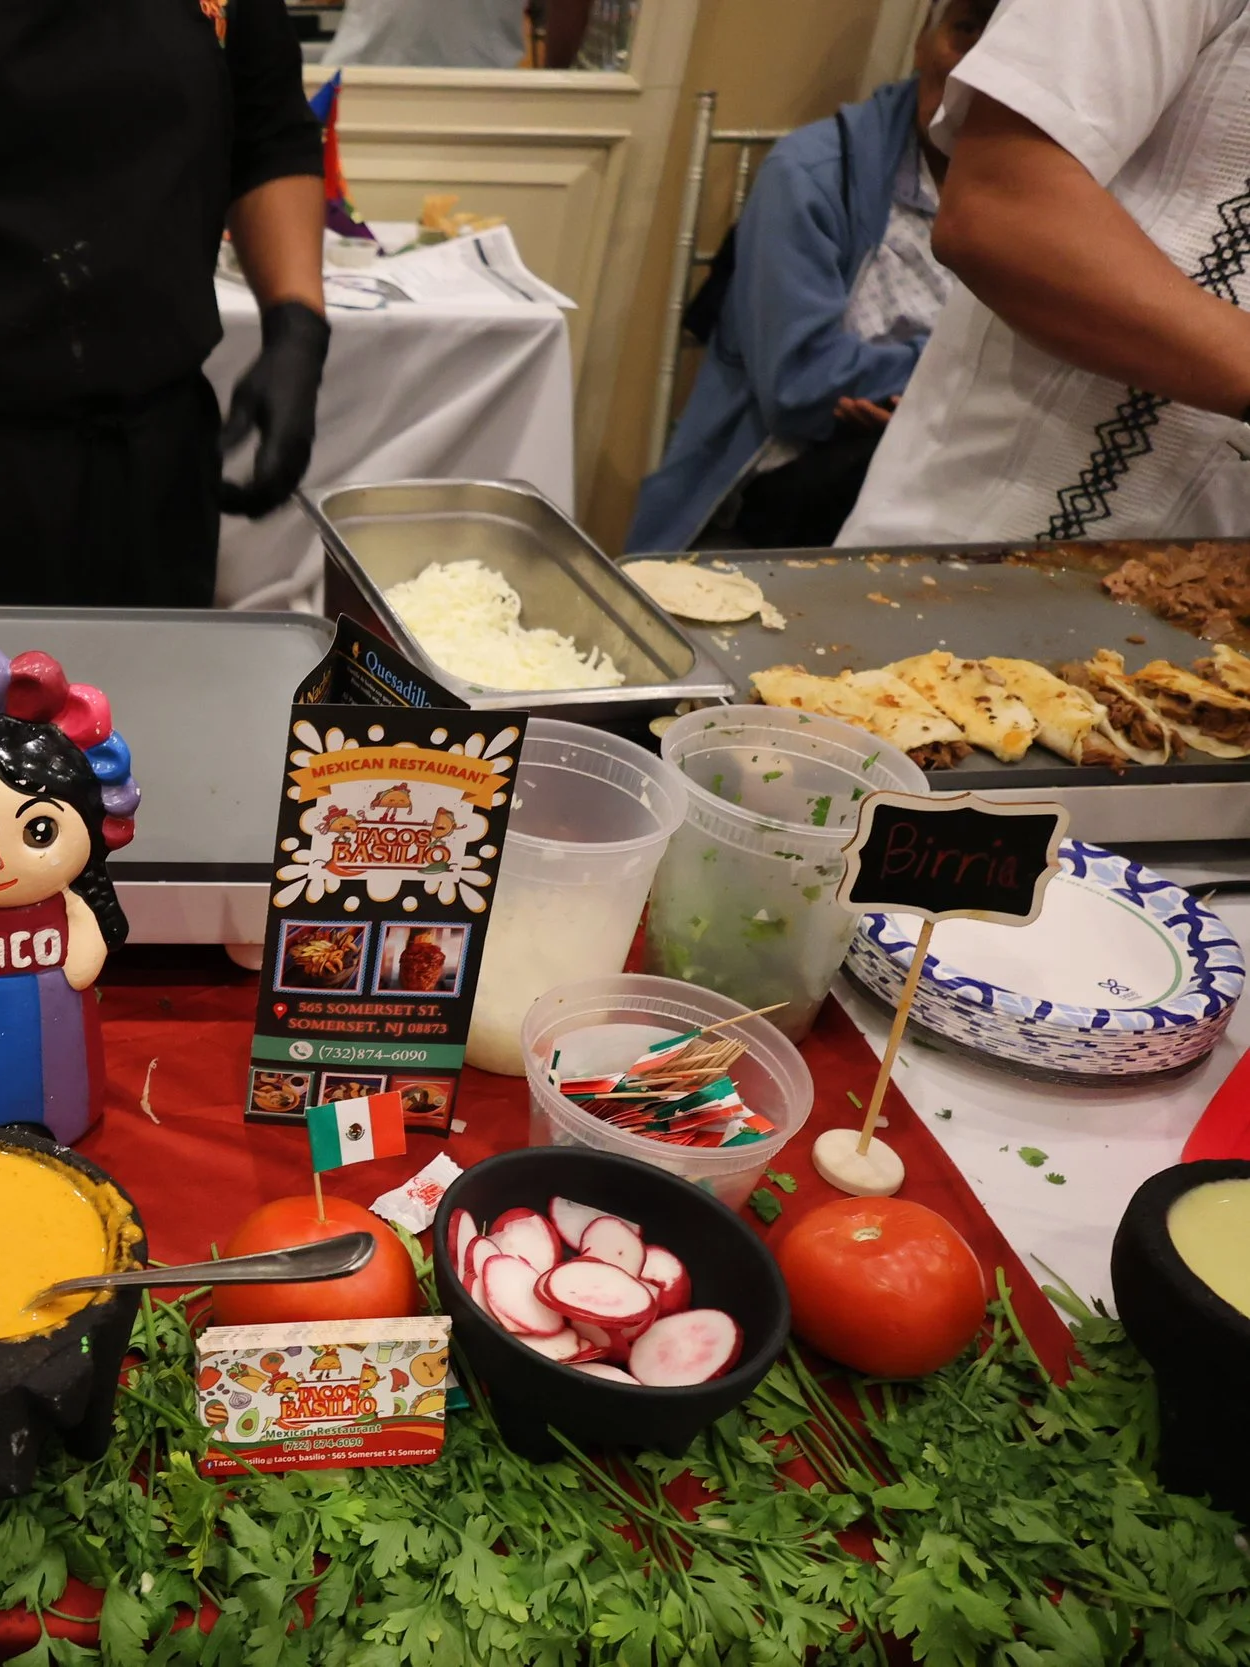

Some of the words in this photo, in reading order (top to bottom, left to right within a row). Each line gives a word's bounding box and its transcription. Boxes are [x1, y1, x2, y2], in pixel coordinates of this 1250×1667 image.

[312, 758, 384, 779] MEXICAN
[388, 758, 490, 785] RESTAURANT
[354, 826, 432, 848] TACOS
[331, 844, 452, 865] BASILIO
[880, 822, 1019, 889] Birria
[298, 1002, 323, 1014] 565
[326, 1002, 415, 1017] SOMERSET
[417, 1005, 442, 1017] ST.
[384, 1022, 403, 1037] NJ
[407, 1023, 448, 1035] 08873
[318, 1045, 428, 1062] (732)874-6090
[297, 1384, 361, 1401] TACOS
[280, 1398, 378, 1419] BASILIO
[265, 1428, 314, 1439] Mexican
[316, 1424, 382, 1436] Restaurant
[274, 1453, 326, 1464] tacos_basilio
[348, 1450, 386, 1459] Somerset
[388, 1449, 396, 1457] St
[397, 1448, 437, 1456] Somerset
